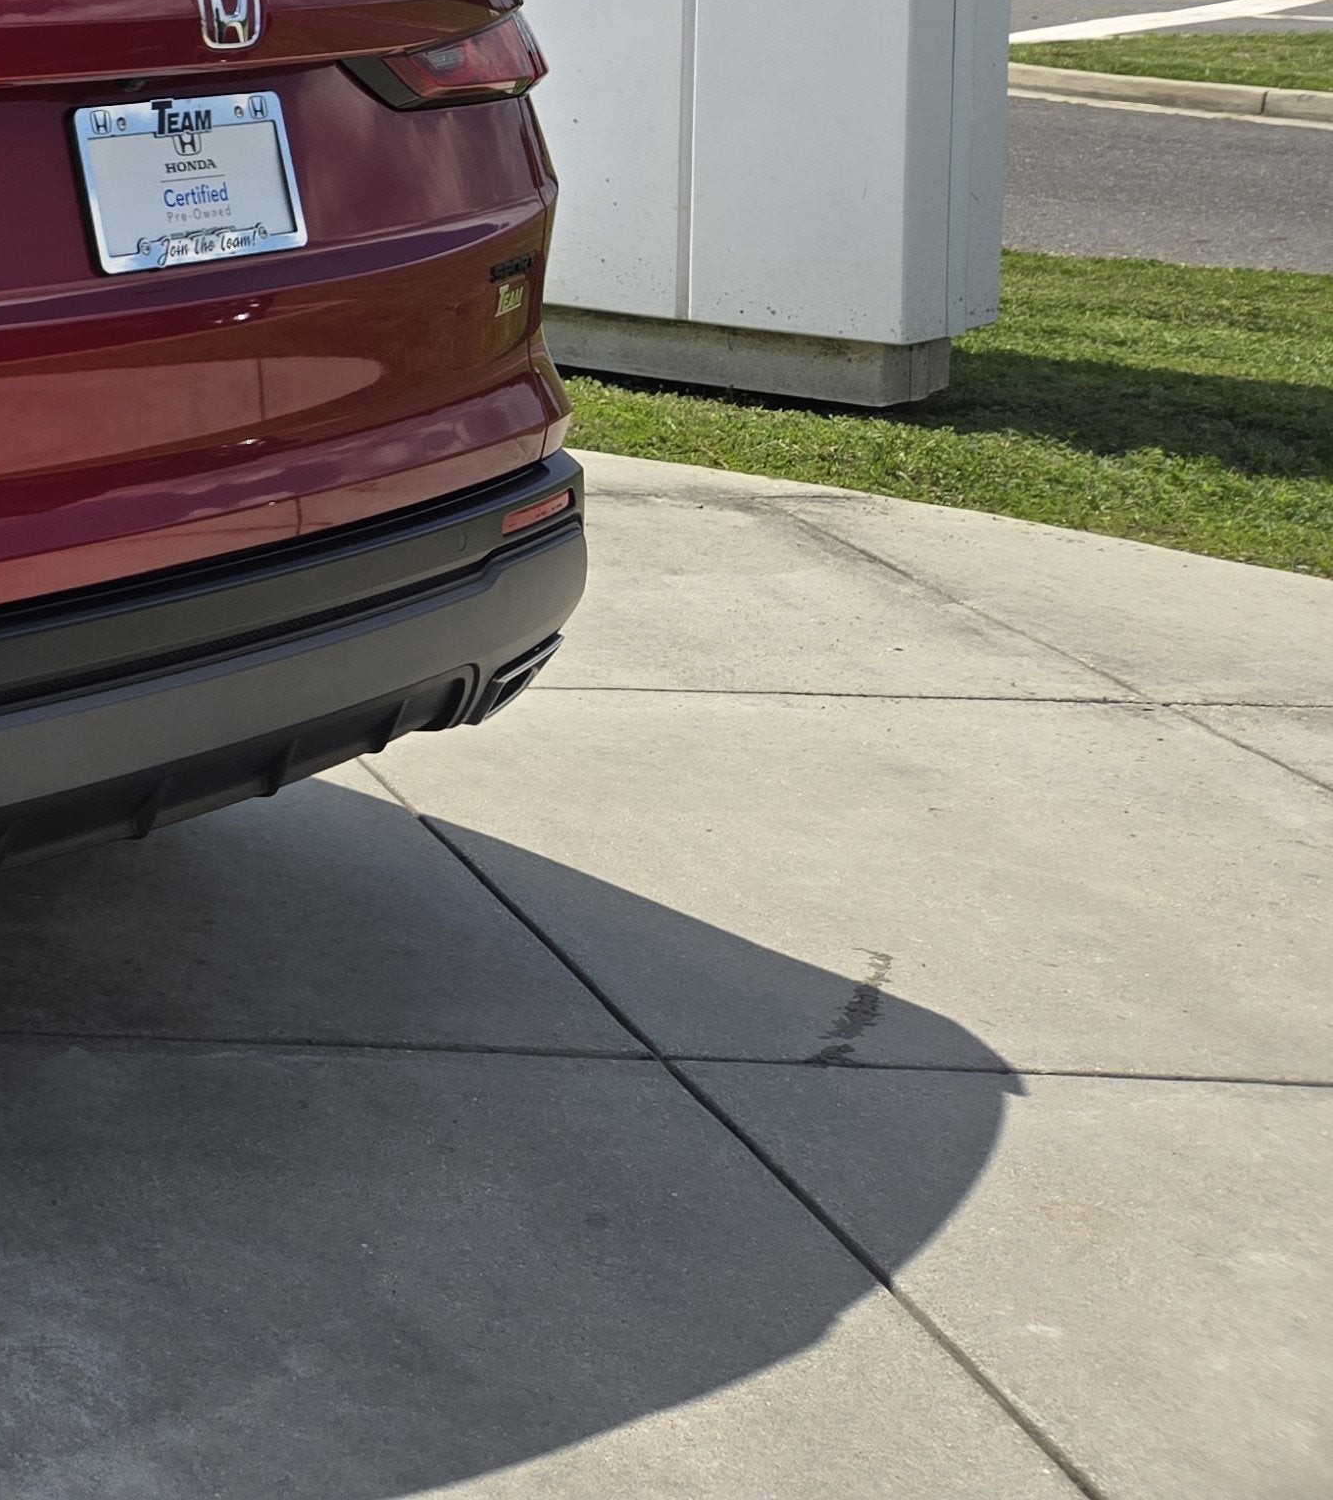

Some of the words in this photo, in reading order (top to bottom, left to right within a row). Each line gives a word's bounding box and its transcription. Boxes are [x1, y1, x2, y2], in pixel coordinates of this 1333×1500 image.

[151, 100, 212, 135] TEAM
[165, 159, 217, 173] HONDA
[163, 182, 229, 208] Certified
[167, 205, 232, 223] Pre-Owned
[157, 238, 189, 267] Join
